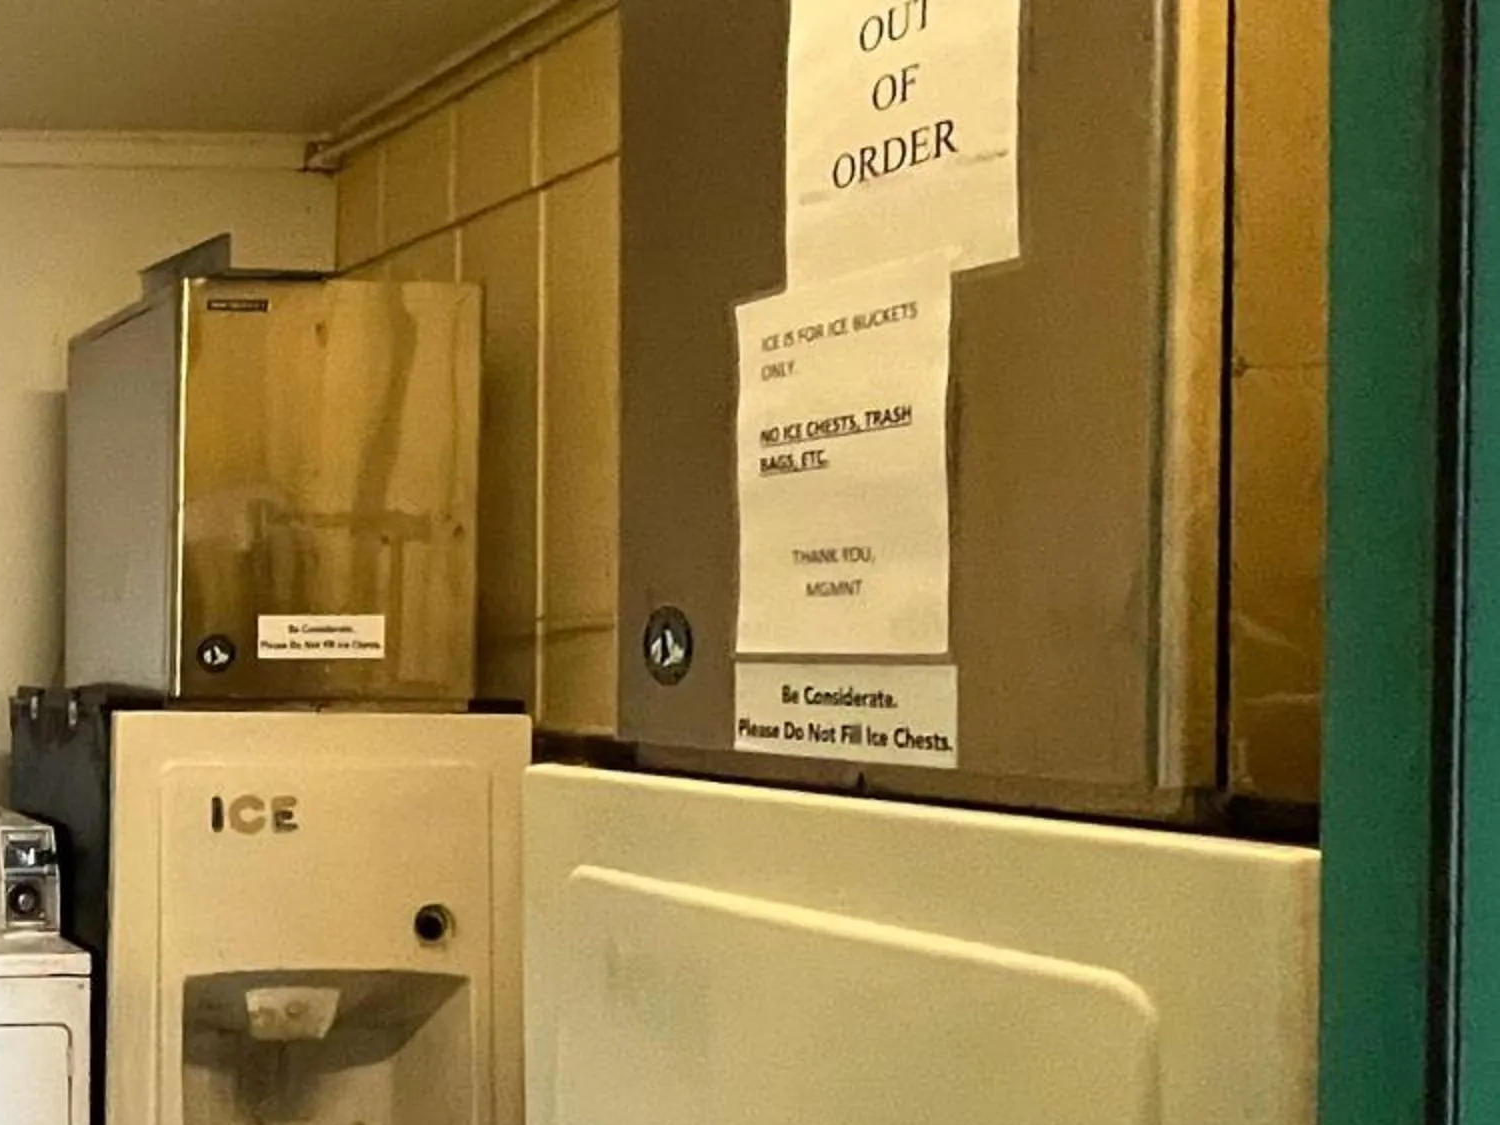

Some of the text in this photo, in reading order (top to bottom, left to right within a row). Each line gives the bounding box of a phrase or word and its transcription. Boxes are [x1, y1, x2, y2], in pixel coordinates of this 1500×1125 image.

[859, 0, 927, 52] OUT
[872, 63, 920, 111] OF
[832, 119, 958, 189] ORDER
[761, 301, 918, 351] ICE IS FOR ICE BUCKETS
[760, 428, 780, 446] NO
[783, 423, 804, 441] ICE
[864, 405, 913, 431] TRASH
[793, 549, 838, 565] THANK
[806, 580, 863, 597] MGMNT
[782, 685, 898, 709] Be Considerate.
[738, 718, 953, 751] Please Do Not Fill Ice Chests.
[211, 794, 298, 834] ICE
